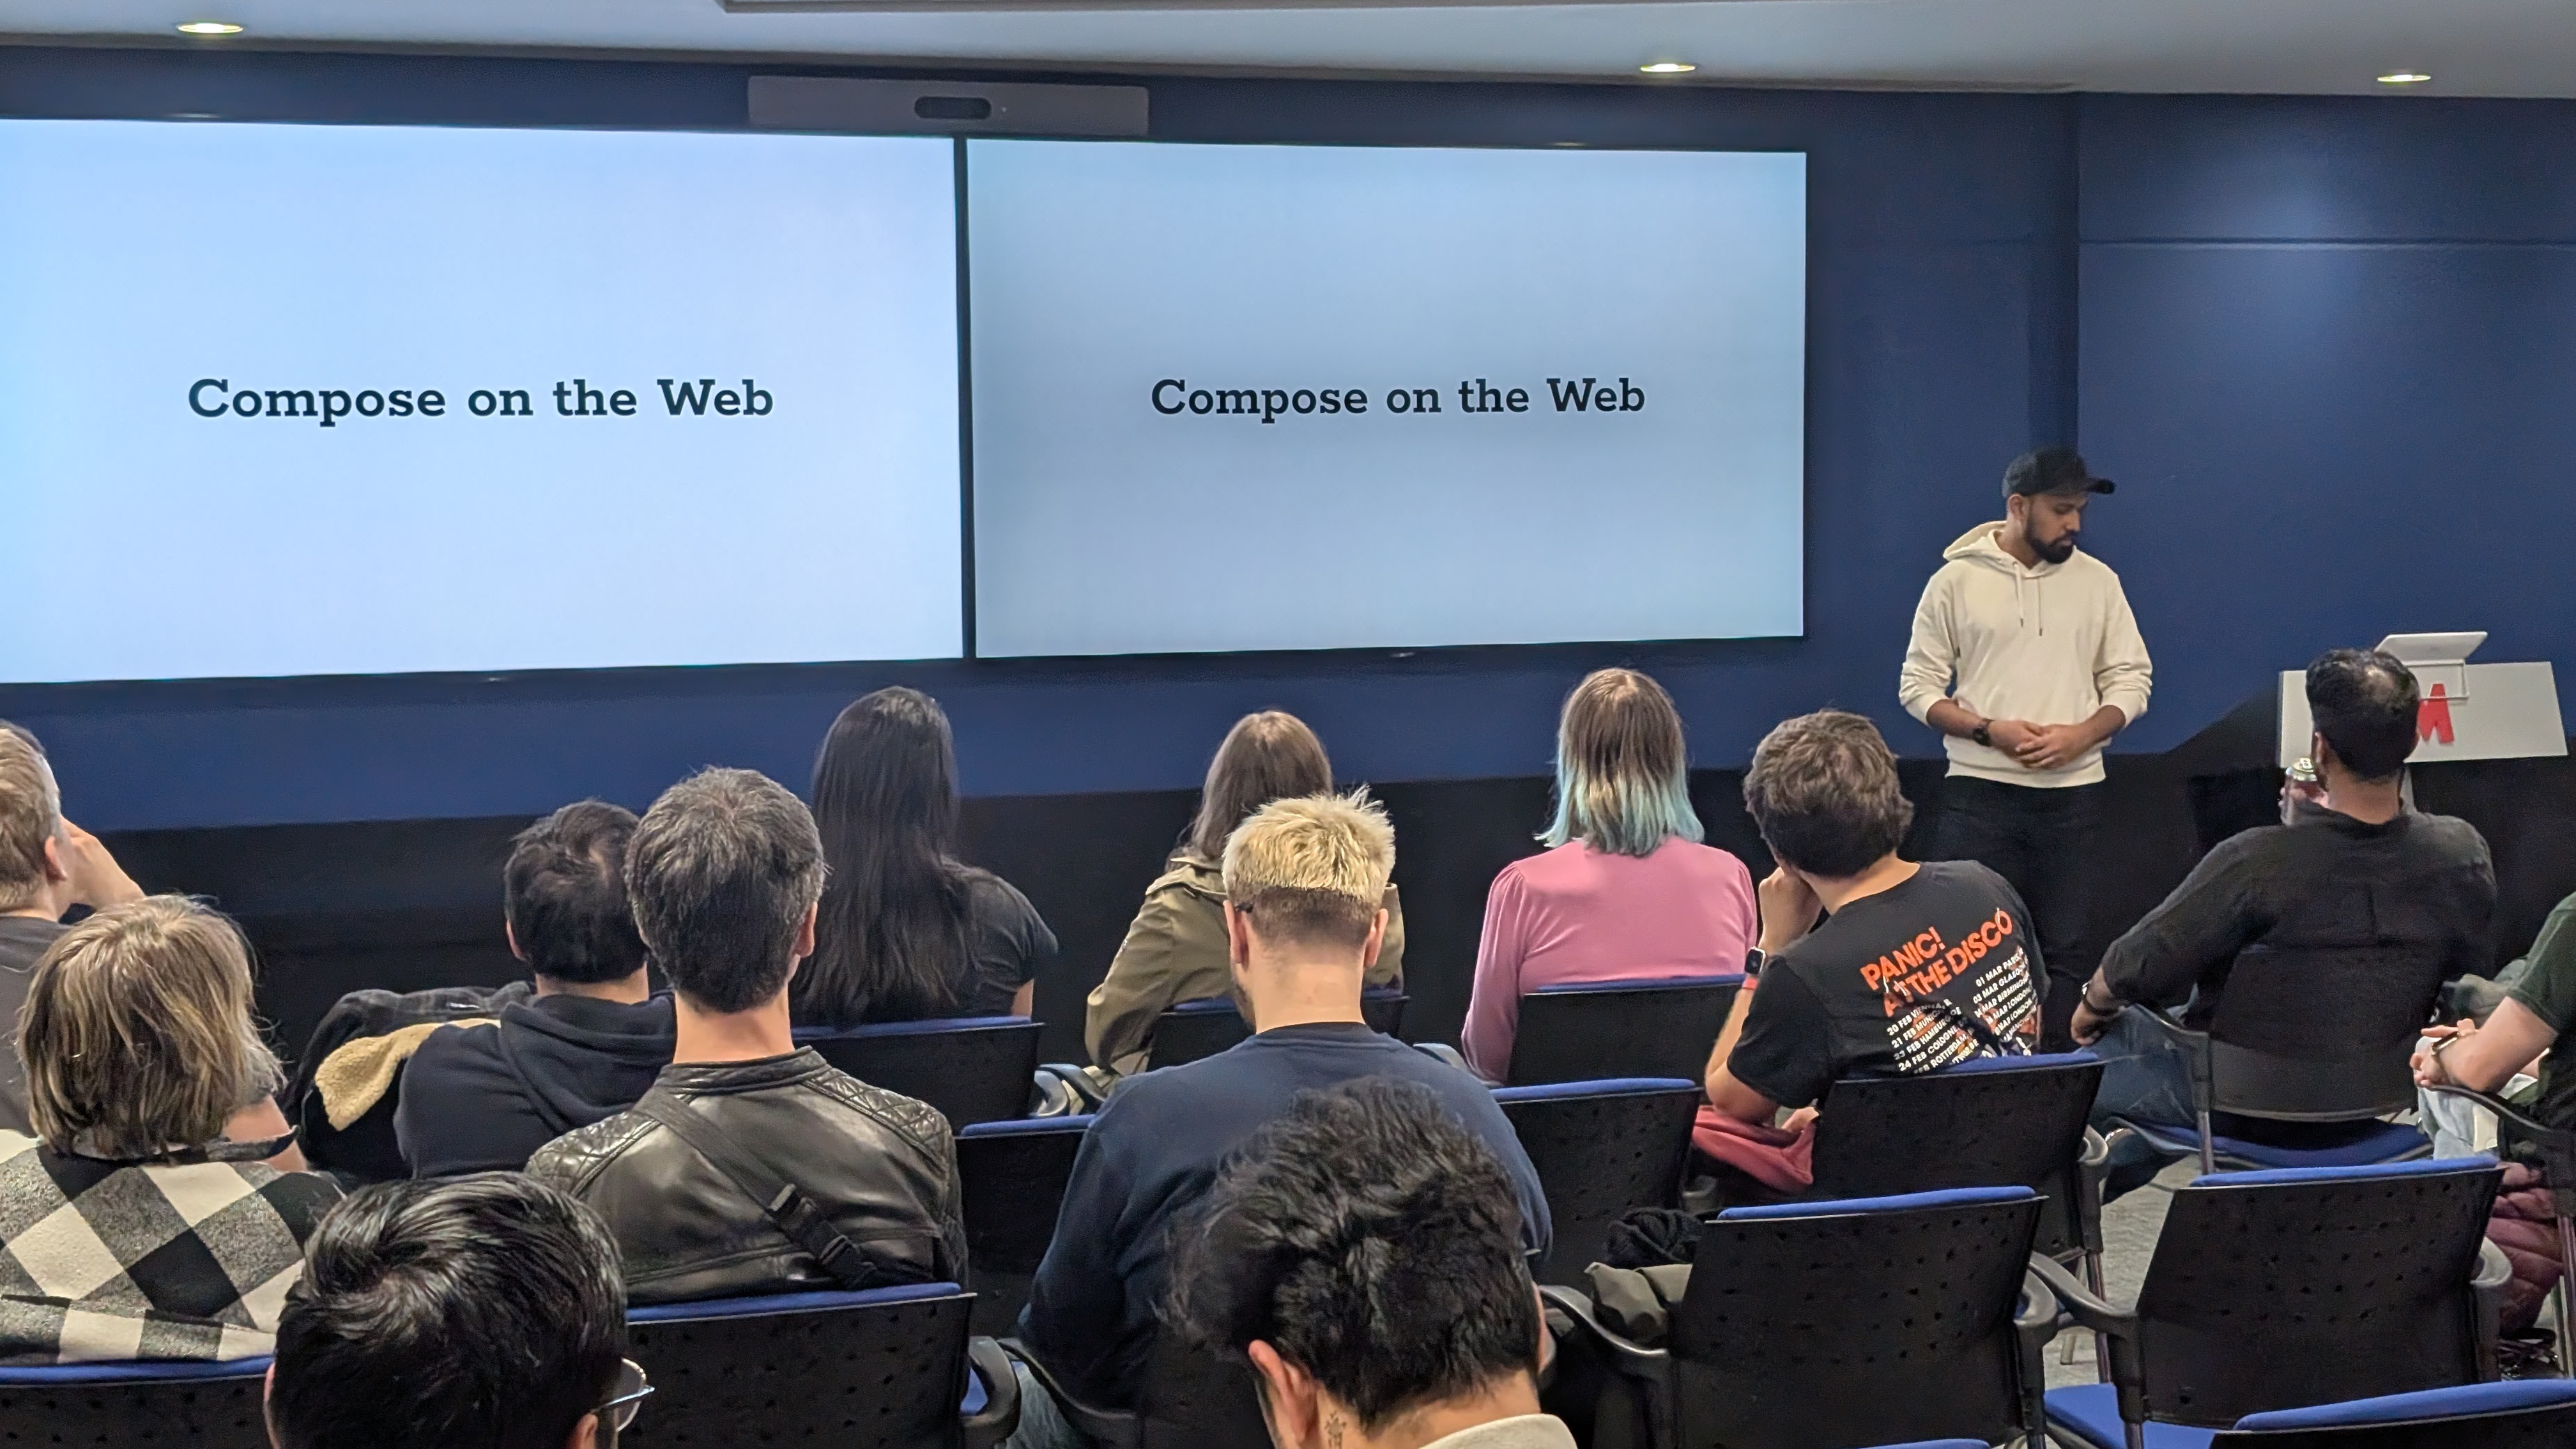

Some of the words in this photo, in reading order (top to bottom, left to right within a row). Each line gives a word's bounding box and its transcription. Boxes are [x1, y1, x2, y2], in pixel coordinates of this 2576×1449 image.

[188, 378, 446, 428] Compose
[467, 389, 534, 417] on
[552, 378, 638, 417] the
[656, 378, 774, 417] Web
[1151, 378, 1368, 425] Compose
[1386, 388, 1443, 415] on
[1457, 378, 1530, 414] the
[1545, 376, 1646, 413] Web
[1860, 926, 1946, 991] PANIC!
[1905, 959, 1952, 996] THE
[1945, 910, 2013, 976] DISCO
[1975, 976, 1986, 987] 01
[1985, 965, 2003, 981] MAR
[1973, 993, 1982, 1004] 03
[1982, 983, 1998, 999] MAR
[1982, 999, 1998, 1013] MAR
[1887, 1024, 1899, 1036] 20
[1897, 1015, 1912, 1028] FEB
[1891, 1037, 1903, 1048] 21
[1903, 1027, 1917, 1041] FEB
[1894, 1050, 1906, 1060] 23
[1906, 1041, 1922, 1054] FEB
[1898, 1059, 1912, 1071] 24
[1912, 1051, 1928, 1065] FEB
